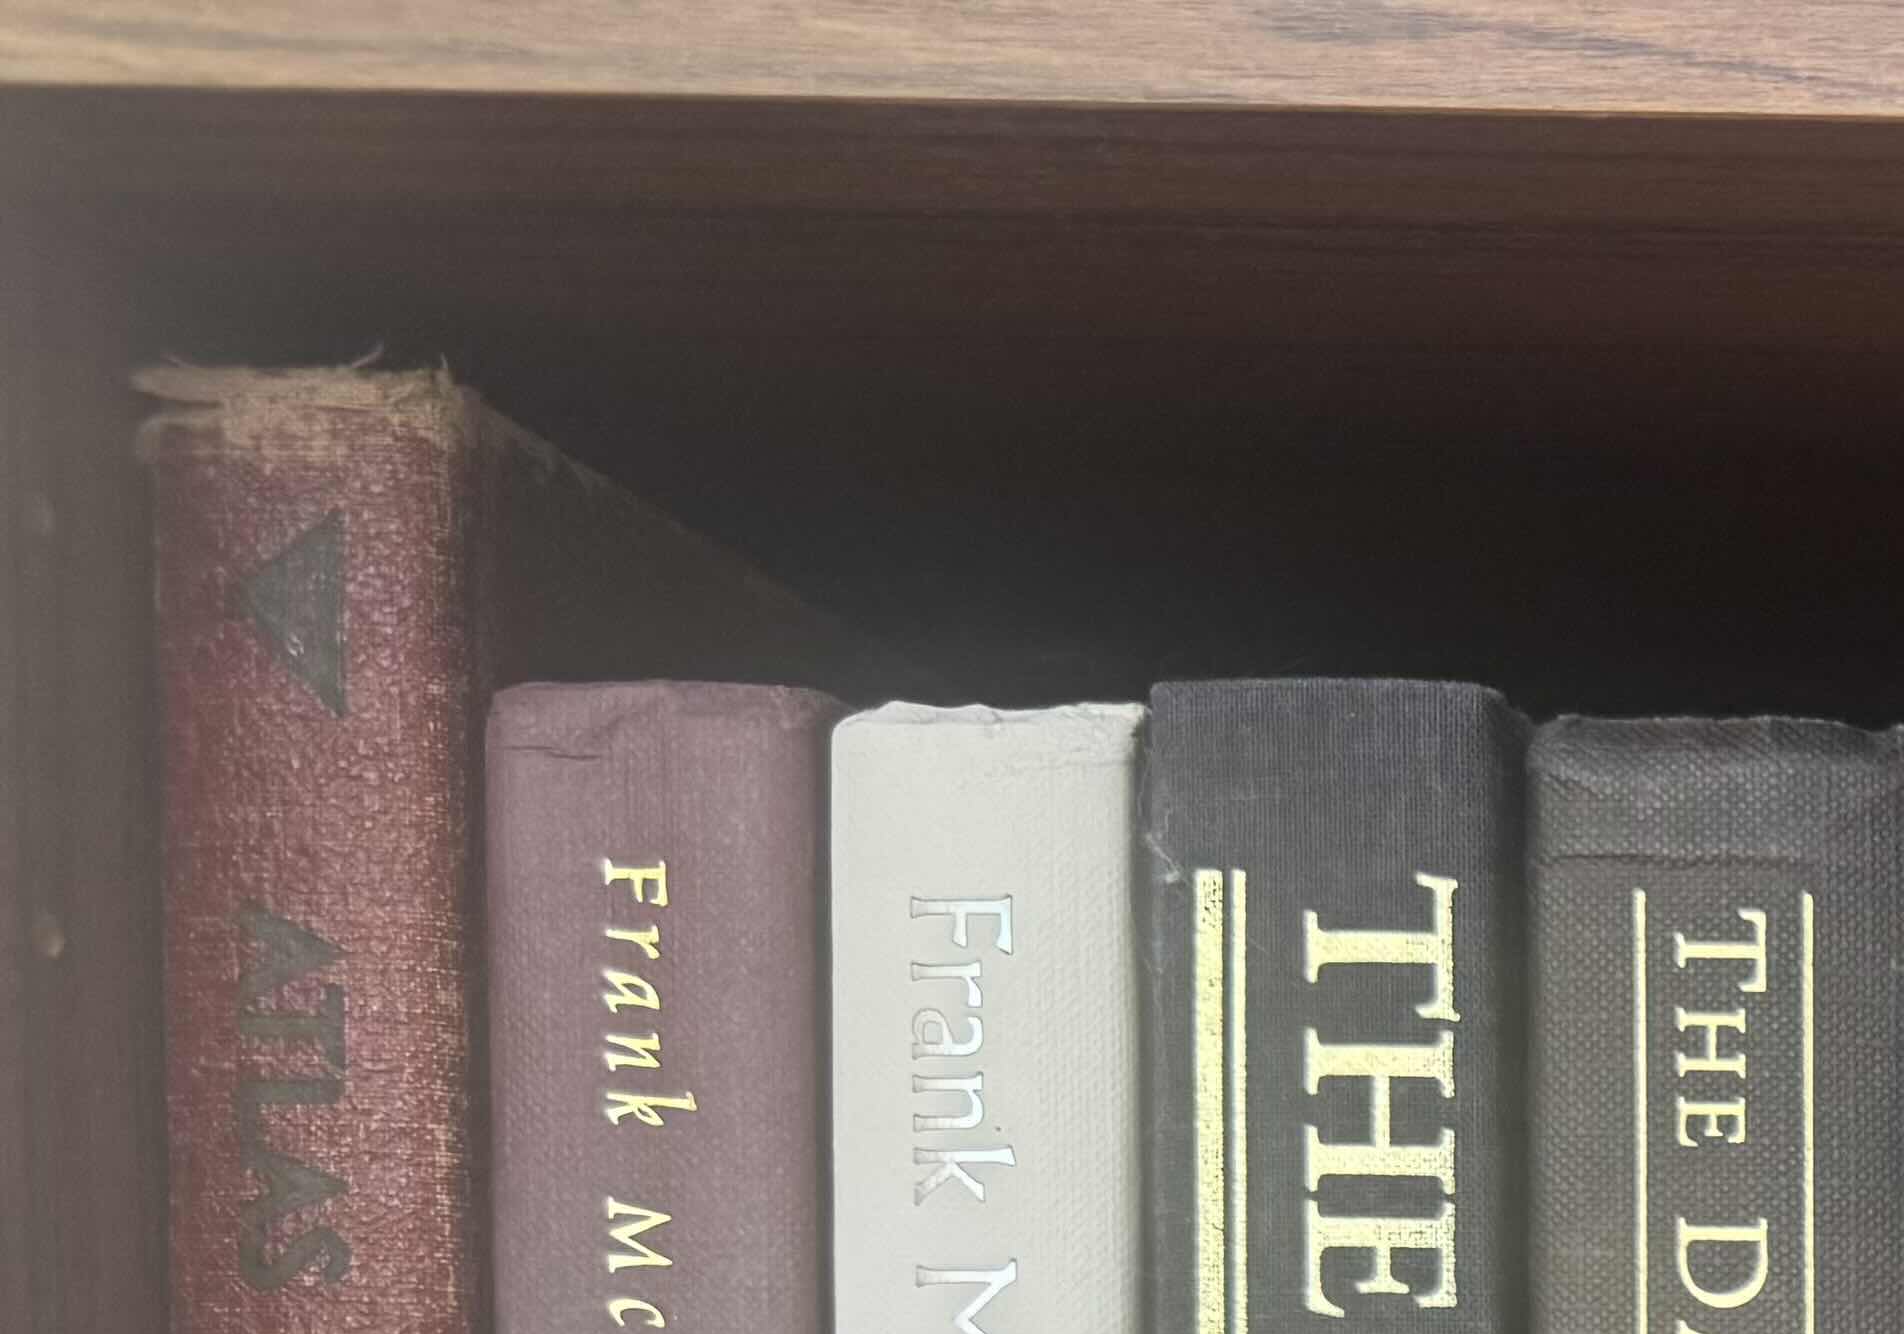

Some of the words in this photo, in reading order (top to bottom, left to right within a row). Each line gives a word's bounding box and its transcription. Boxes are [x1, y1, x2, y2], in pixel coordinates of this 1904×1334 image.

[238, 908, 351, 1292] ATLAS
[603, 857, 697, 1130] Frank
[907, 894, 1018, 1207] Frank
[1306, 873, 1463, 1317] THE
[1673, 905, 1768, 1149] THE
